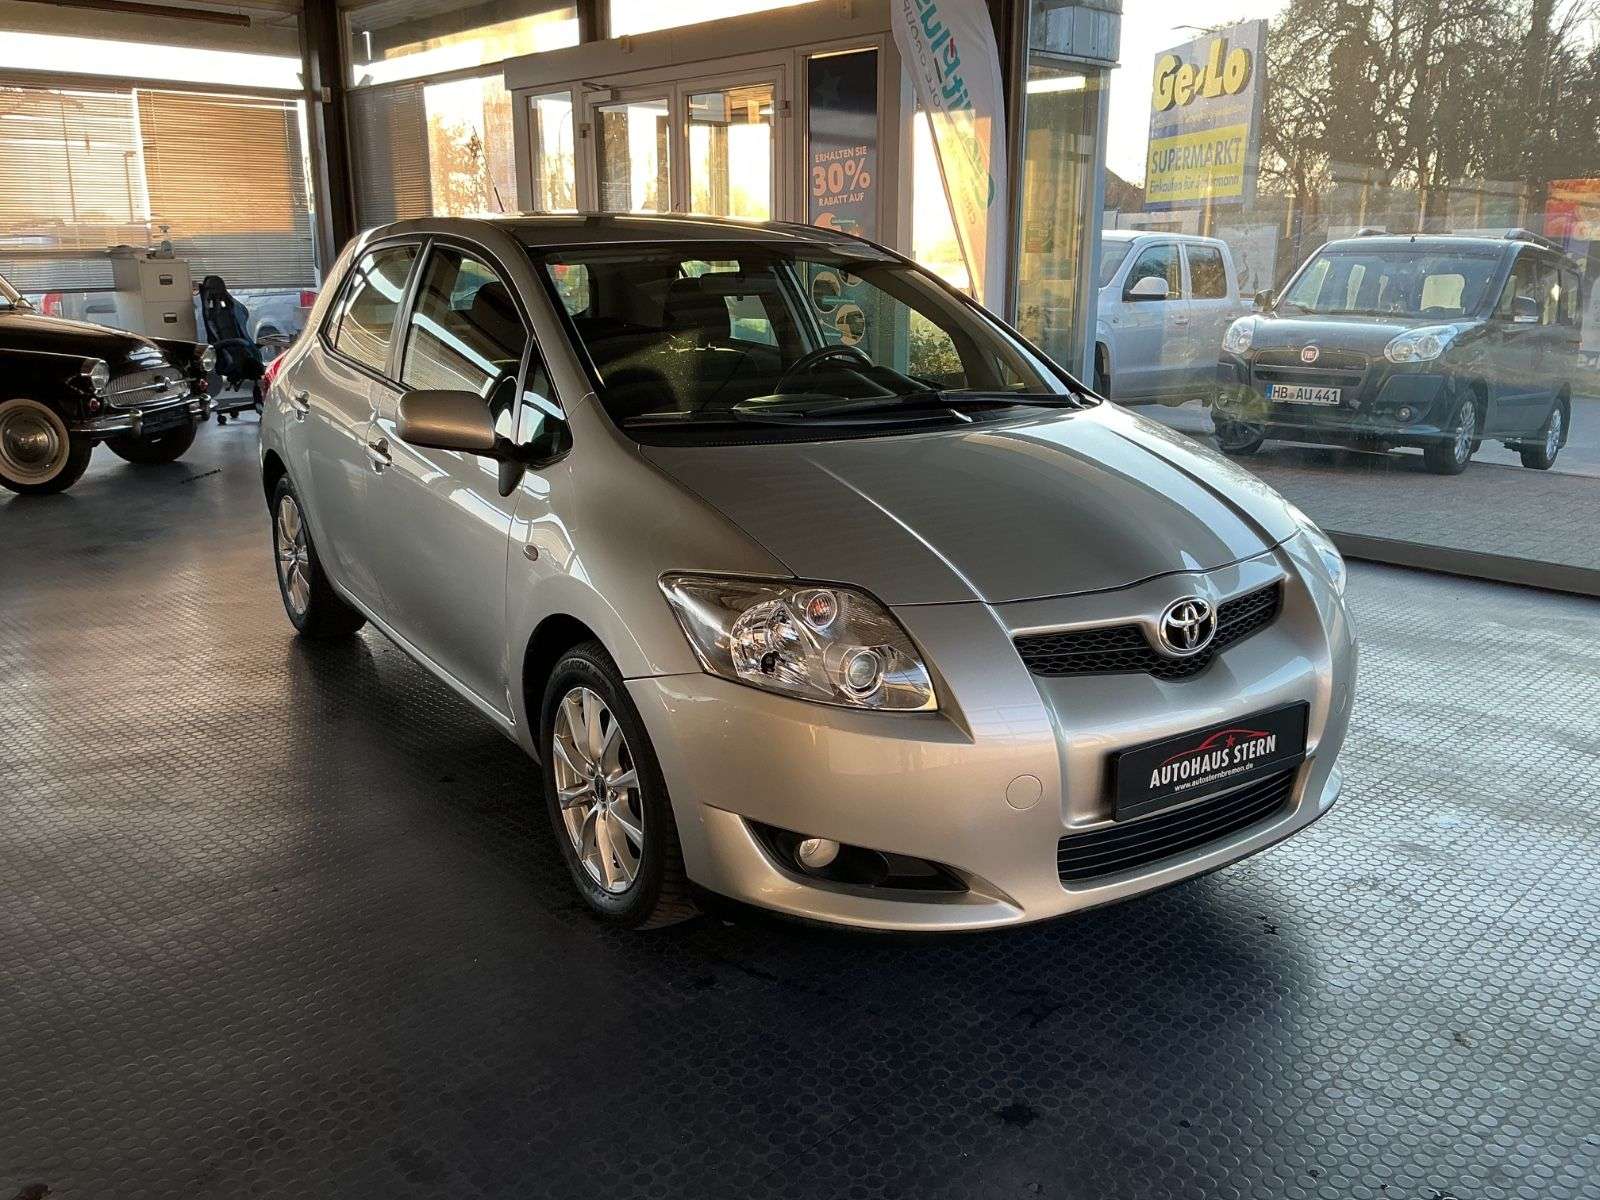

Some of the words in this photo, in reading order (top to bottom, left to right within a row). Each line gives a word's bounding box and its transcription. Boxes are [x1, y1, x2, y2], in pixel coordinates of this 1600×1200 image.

[815, 149, 854, 163] ERHALTEN
[855, 145, 867, 157] SIE
[1151, 137, 1242, 174] SUPERMARKT
[812, 157, 871, 197] 30%
[819, 194, 848, 207] RABATT
[849, 192, 865, 204] AUF
[1272, 386, 1288, 399] HB
[1296, 388, 1313, 401] AU
[1315, 388, 1339, 403] 441
[1150, 748, 1230, 789] AUTOHAUS
[1233, 734, 1277, 764] STERN
[1174, 763, 1254, 792] www.autosternbremen.de
